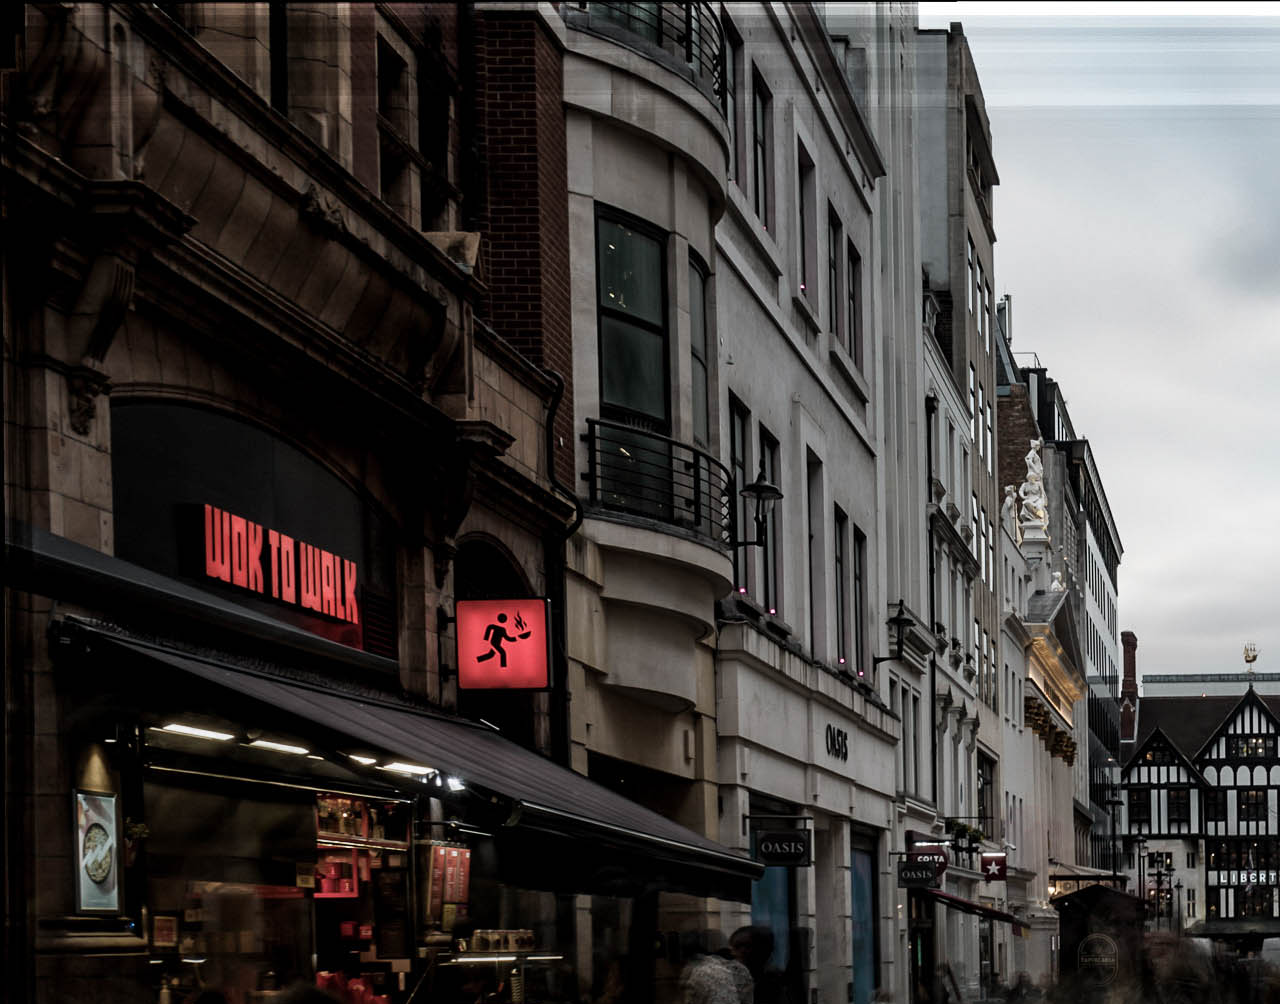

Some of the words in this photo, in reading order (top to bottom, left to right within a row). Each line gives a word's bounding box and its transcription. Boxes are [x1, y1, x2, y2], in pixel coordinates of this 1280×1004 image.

[204, 503, 264, 595] WOK
[268, 528, 296, 605] TO
[300, 541, 359, 625] WALK
[825, 723, 849, 764] OASIS
[760, 841, 805, 854] OASIS
[902, 869, 933, 880] OASIS
